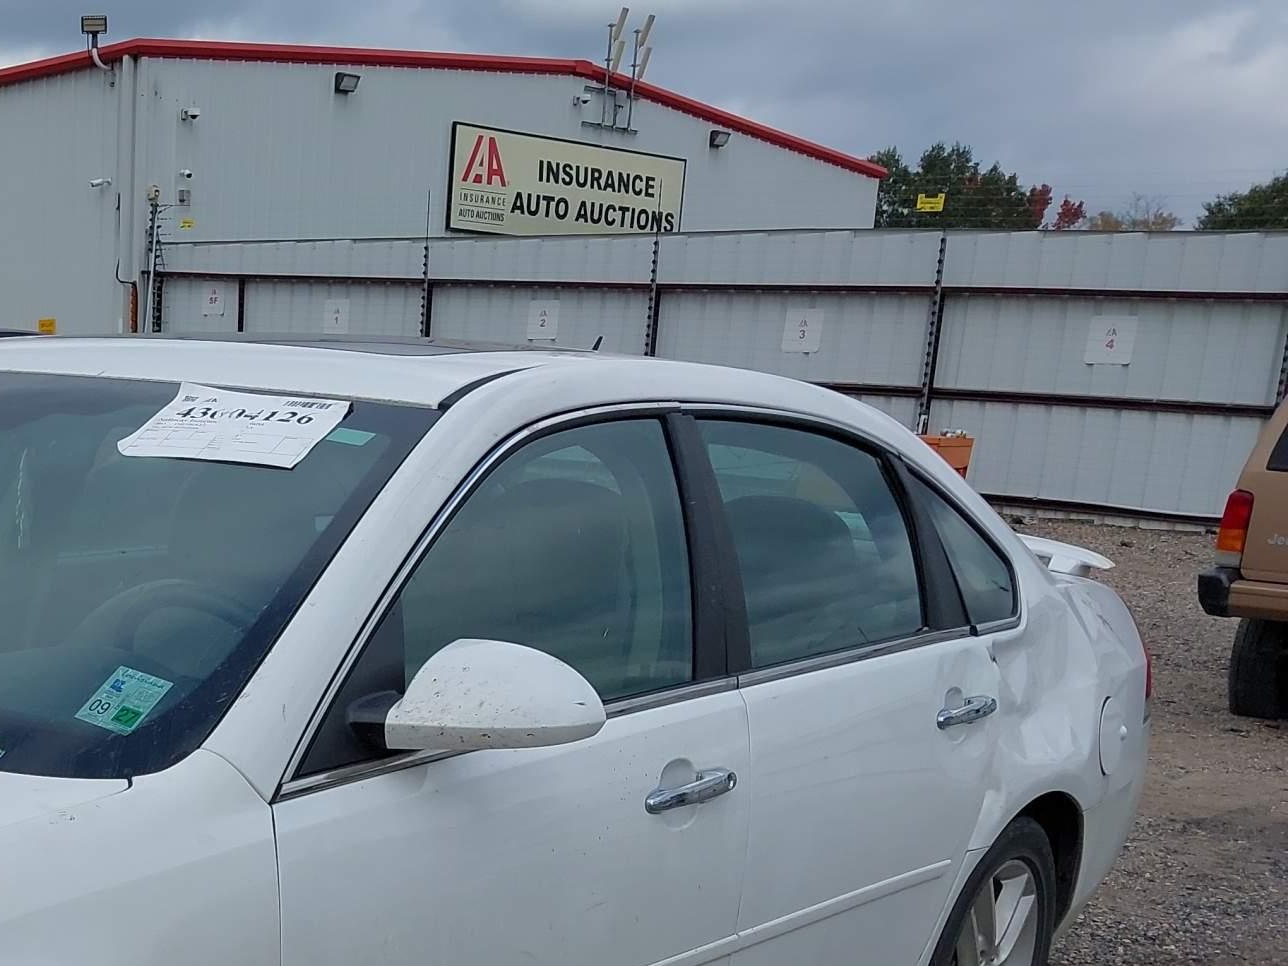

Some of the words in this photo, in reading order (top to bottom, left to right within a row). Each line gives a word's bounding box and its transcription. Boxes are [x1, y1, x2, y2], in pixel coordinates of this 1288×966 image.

[538, 160, 656, 198] INSURANCE
[459, 191, 507, 207] INSURANCE
[458, 208, 475, 218] AUTO
[475, 209, 505, 222] AUCTIONS
[510, 192, 569, 220] AUTO
[574, 200, 674, 232] AUCTIONS
[539, 318, 546, 327] 2
[799, 329, 806, 339] 3
[1105, 338, 1114, 350] 4
[88, 698, 111, 715] 09
[117, 708, 139, 724] 27
